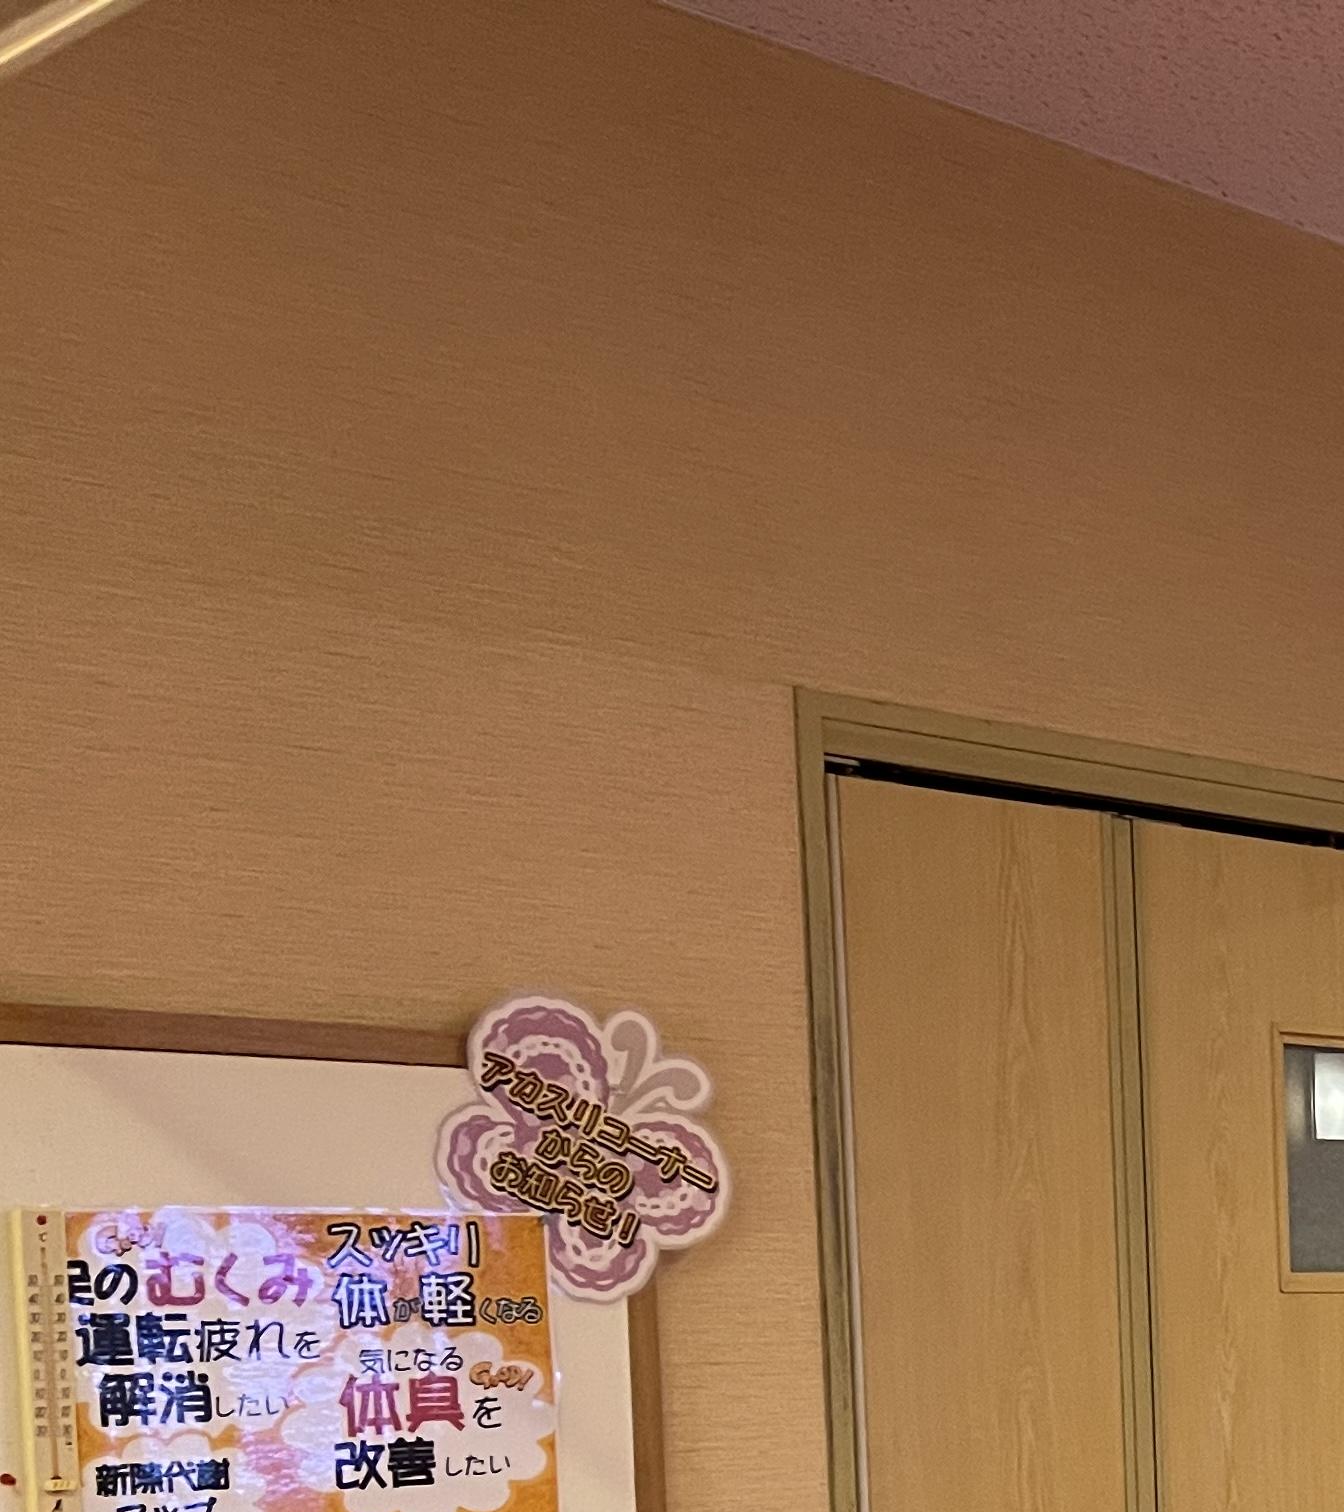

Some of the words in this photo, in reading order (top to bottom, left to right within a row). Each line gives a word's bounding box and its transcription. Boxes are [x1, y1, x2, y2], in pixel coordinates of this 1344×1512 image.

[480, 1051, 719, 1193] アカスリコーナー
[534, 1127, 634, 1199] からの
[488, 1150, 642, 1249] お知らせ!
[326, 1221, 481, 1269] スッキリ
[331, 1271, 544, 1330] 体が軽くなる
[76, 1312, 322, 1367] 運転疲れを
[358, 1347, 465, 1375] 気になる
[99, 1370, 291, 1428] 解消したい
[333, 1436, 512, 1491] 改善したい
